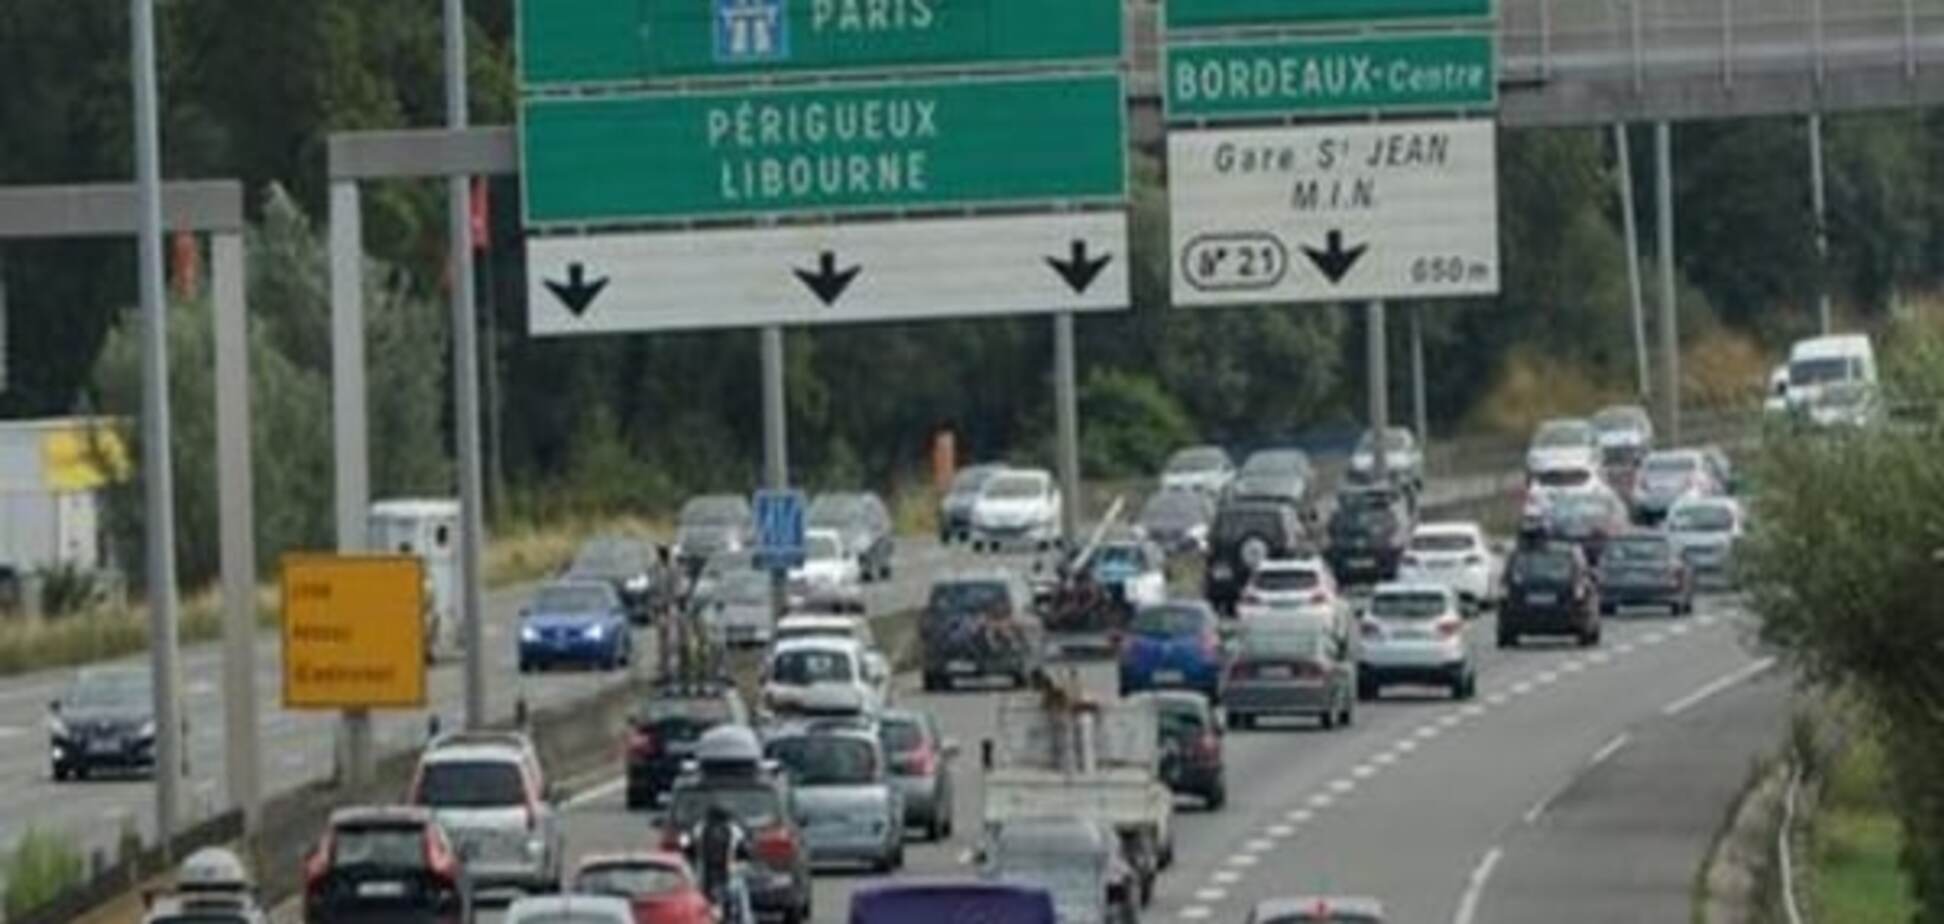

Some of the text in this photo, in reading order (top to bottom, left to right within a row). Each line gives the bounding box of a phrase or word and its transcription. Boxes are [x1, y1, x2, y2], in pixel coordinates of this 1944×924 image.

[812, 0, 934, 31] PARIS
[708, 101, 937, 148] PÉRIGUEUX
[1213, 141, 1295, 173] Gare
[1366, 133, 1449, 167] JEAN
[720, 150, 928, 200] LIBOURNE
[1237, 246, 1274, 276] 21
